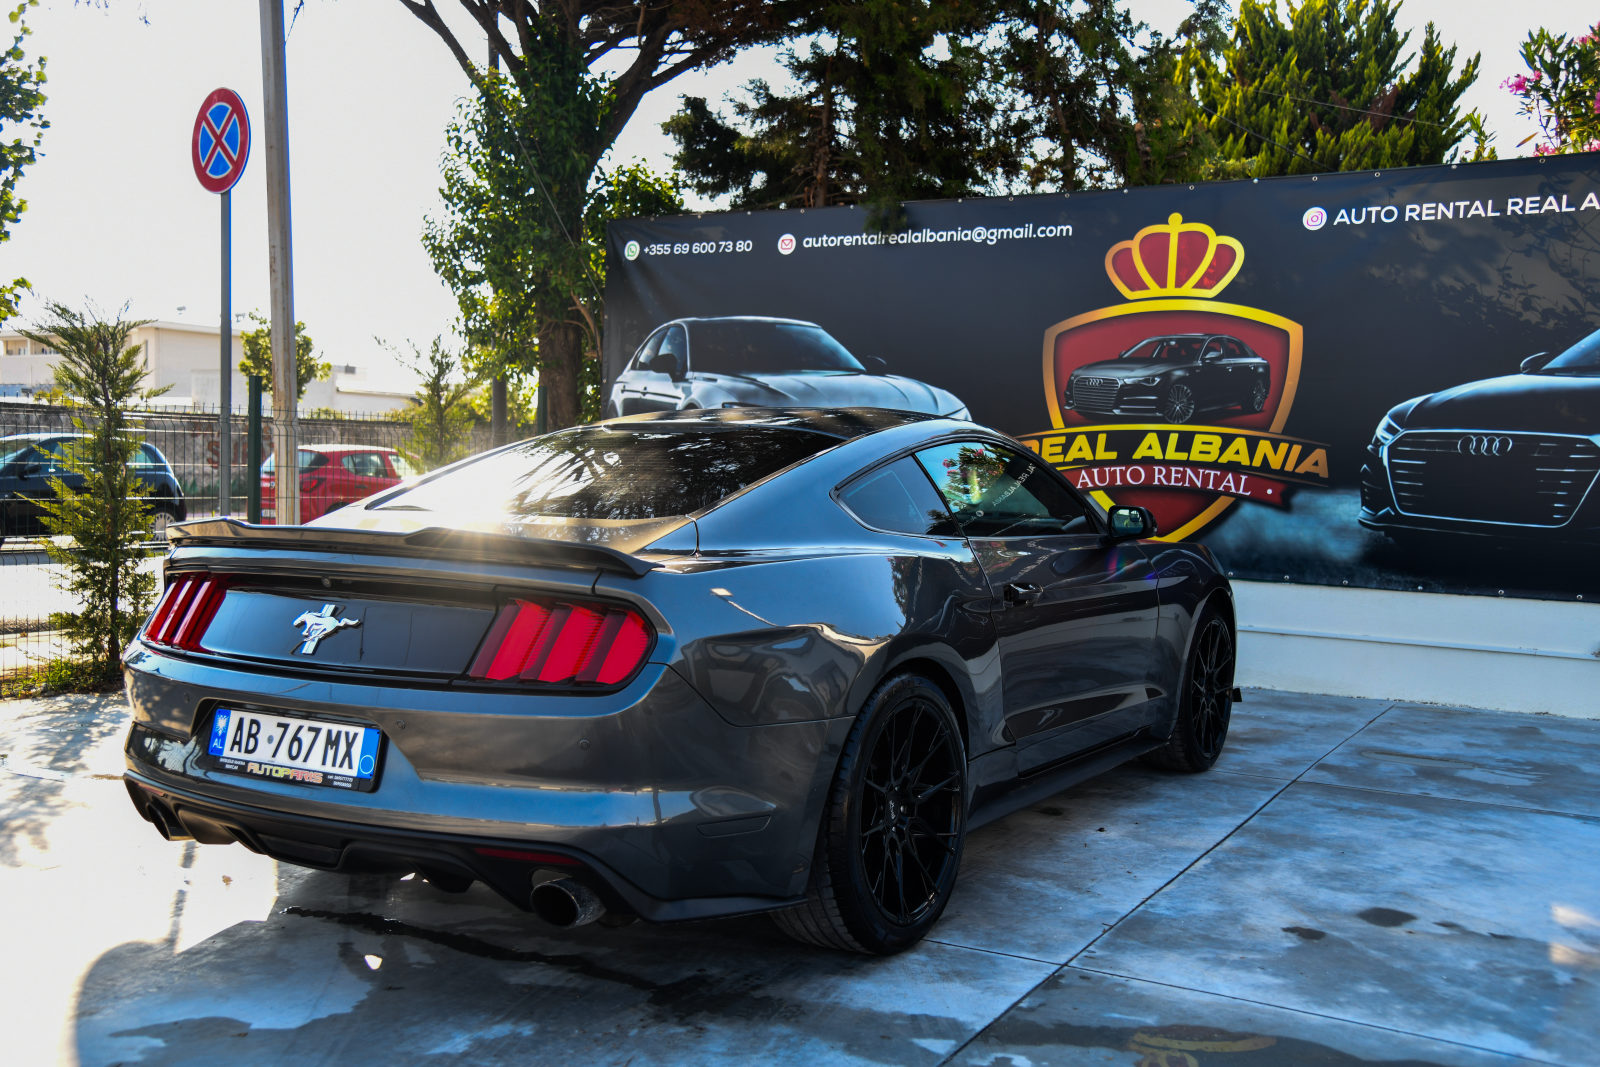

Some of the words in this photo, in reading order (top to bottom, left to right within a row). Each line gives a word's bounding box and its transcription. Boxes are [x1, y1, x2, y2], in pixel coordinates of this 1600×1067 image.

[1333, 205, 1398, 226] AUTO
[1404, 200, 1500, 222] RENTAL
[1506, 194, 1576, 216] REAL
[643, 244, 671, 256] +355
[673, 243, 690, 255] 69
[692, 242, 716, 254] 600
[718, 241, 734, 253] 73
[736, 240, 753, 252] 80
[802, 223, 1073, 249] autorentalrealalbania@gmail.com
[1132, 432, 1329, 478] ALBANIA
[1076, 466, 1146, 489] AUTO
[1152, 466, 1252, 496] RENTAL
[212, 738, 223, 749] AL
[230, 717, 262, 755] AB
